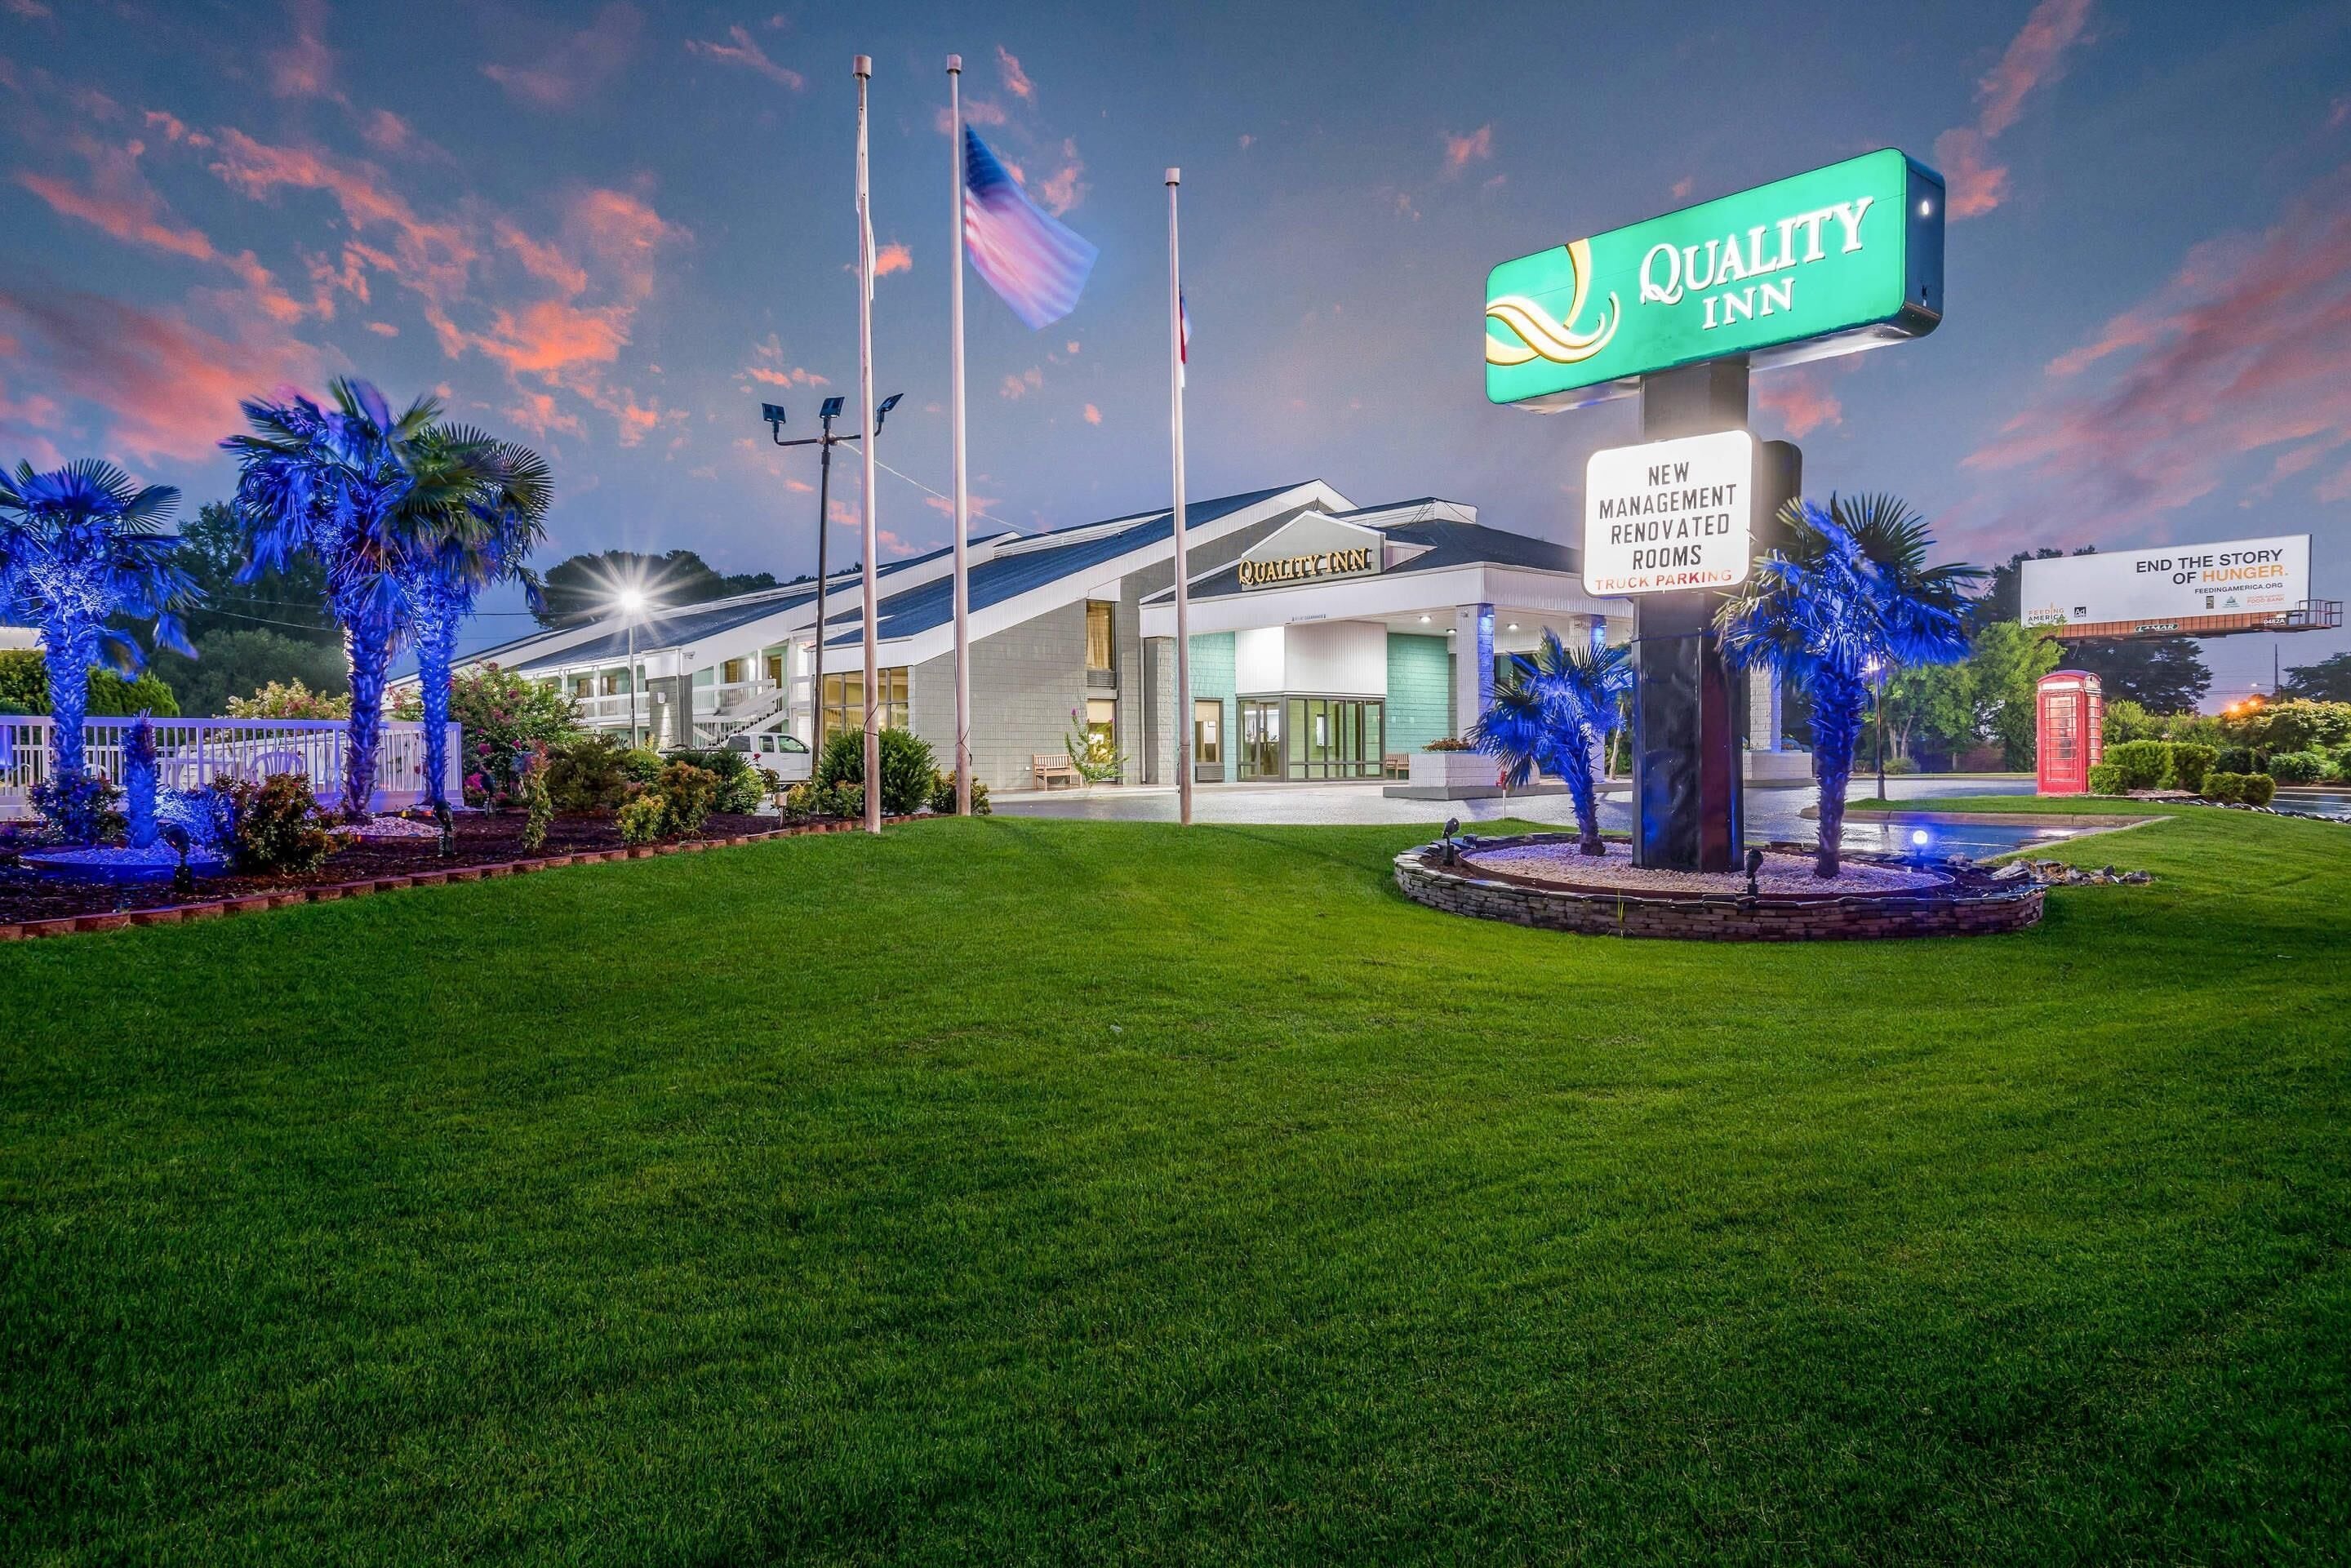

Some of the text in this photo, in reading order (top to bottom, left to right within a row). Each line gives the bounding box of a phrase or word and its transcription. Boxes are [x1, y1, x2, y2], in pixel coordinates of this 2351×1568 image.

[1639, 197, 1874, 305] QUALITY
[1702, 278, 1794, 331] INN
[1648, 462, 1689, 486] NEW
[1599, 484, 1736, 519] MANAGEMENT
[1611, 513, 1729, 544] RENOVATED
[1239, 548, 1368, 585] QUALITY INN
[1633, 544, 1701, 570] ROOMS
[2136, 549, 2283, 573] END THE STORY
[1595, 569, 1732, 590] TRUCK PARKING
[2172, 564, 2289, 584] OF HUNGER.
[2194, 582, 2283, 594] FEEDINGAMERICA.ORG
[2029, 606, 2064, 615] FEEDING
